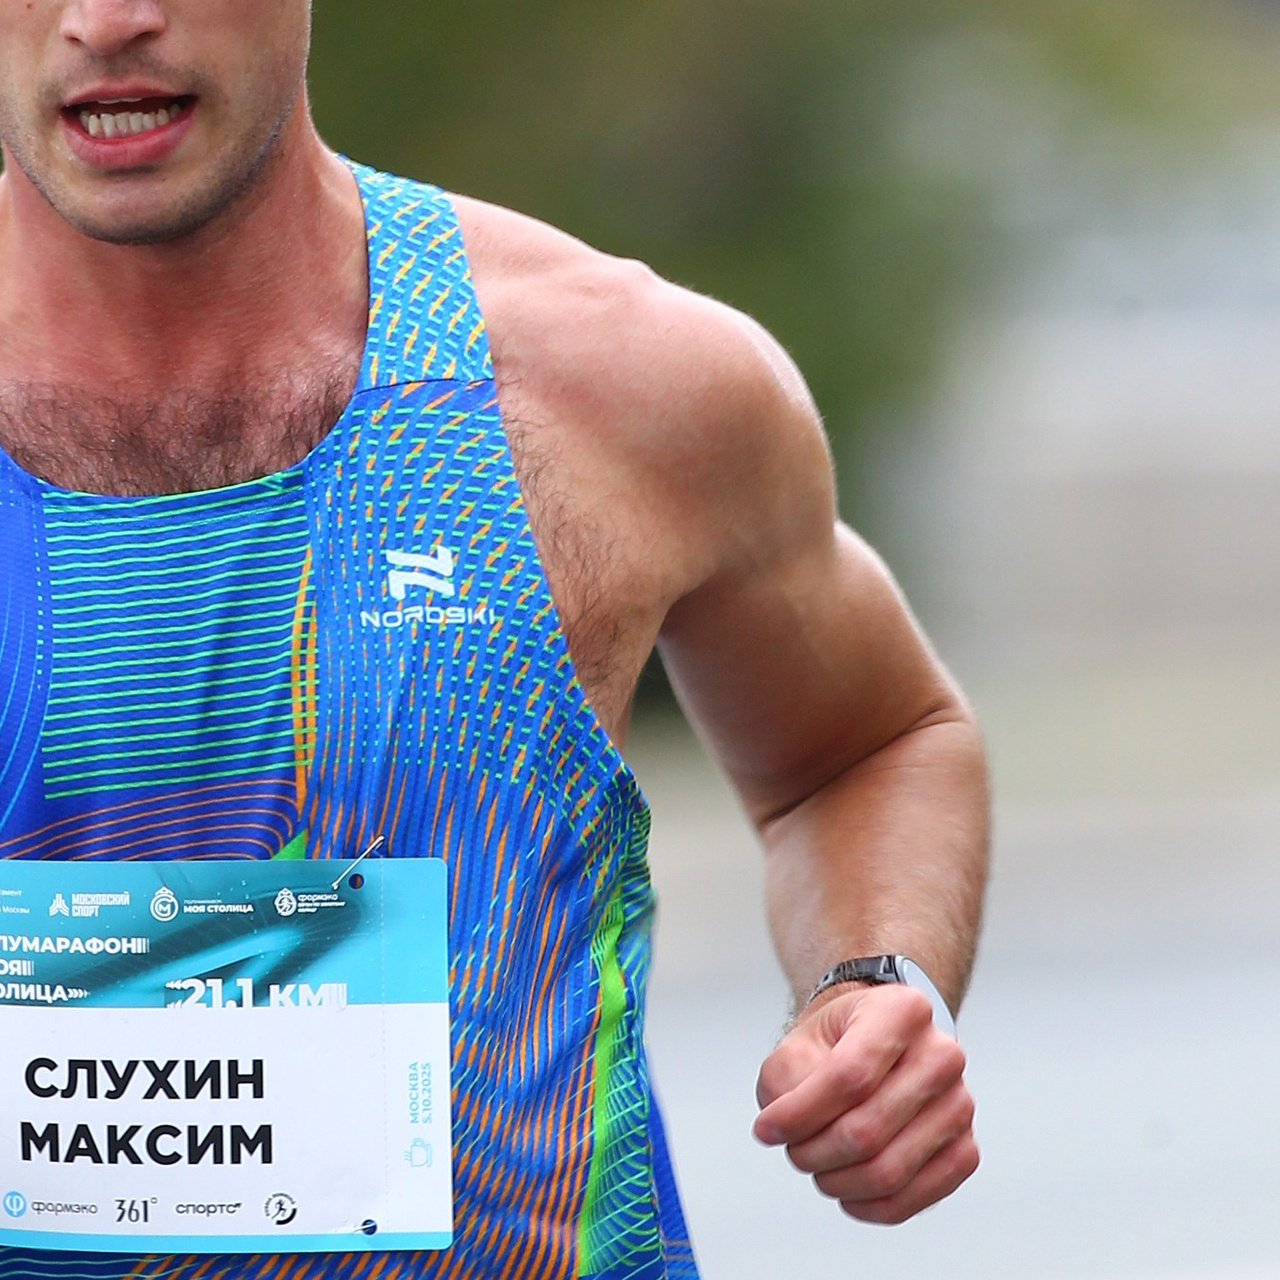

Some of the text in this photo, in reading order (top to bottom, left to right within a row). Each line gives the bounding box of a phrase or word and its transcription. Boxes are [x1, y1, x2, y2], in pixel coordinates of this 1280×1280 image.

[360, 606, 495, 627] NORDSKI
[72, 891, 130, 905] МОСКОВСКИЙ
[72, 905, 99, 917] СПОРТ
[183, 904, 255, 913] МОЯ СТОЛИЦА
[24, 1057, 264, 1100] СЛУХИН
[409, 1061, 419, 1124] МОСКВА
[421, 1062, 432, 1124] 5.10.2025
[20, 1121, 273, 1166] МАКСИМ
